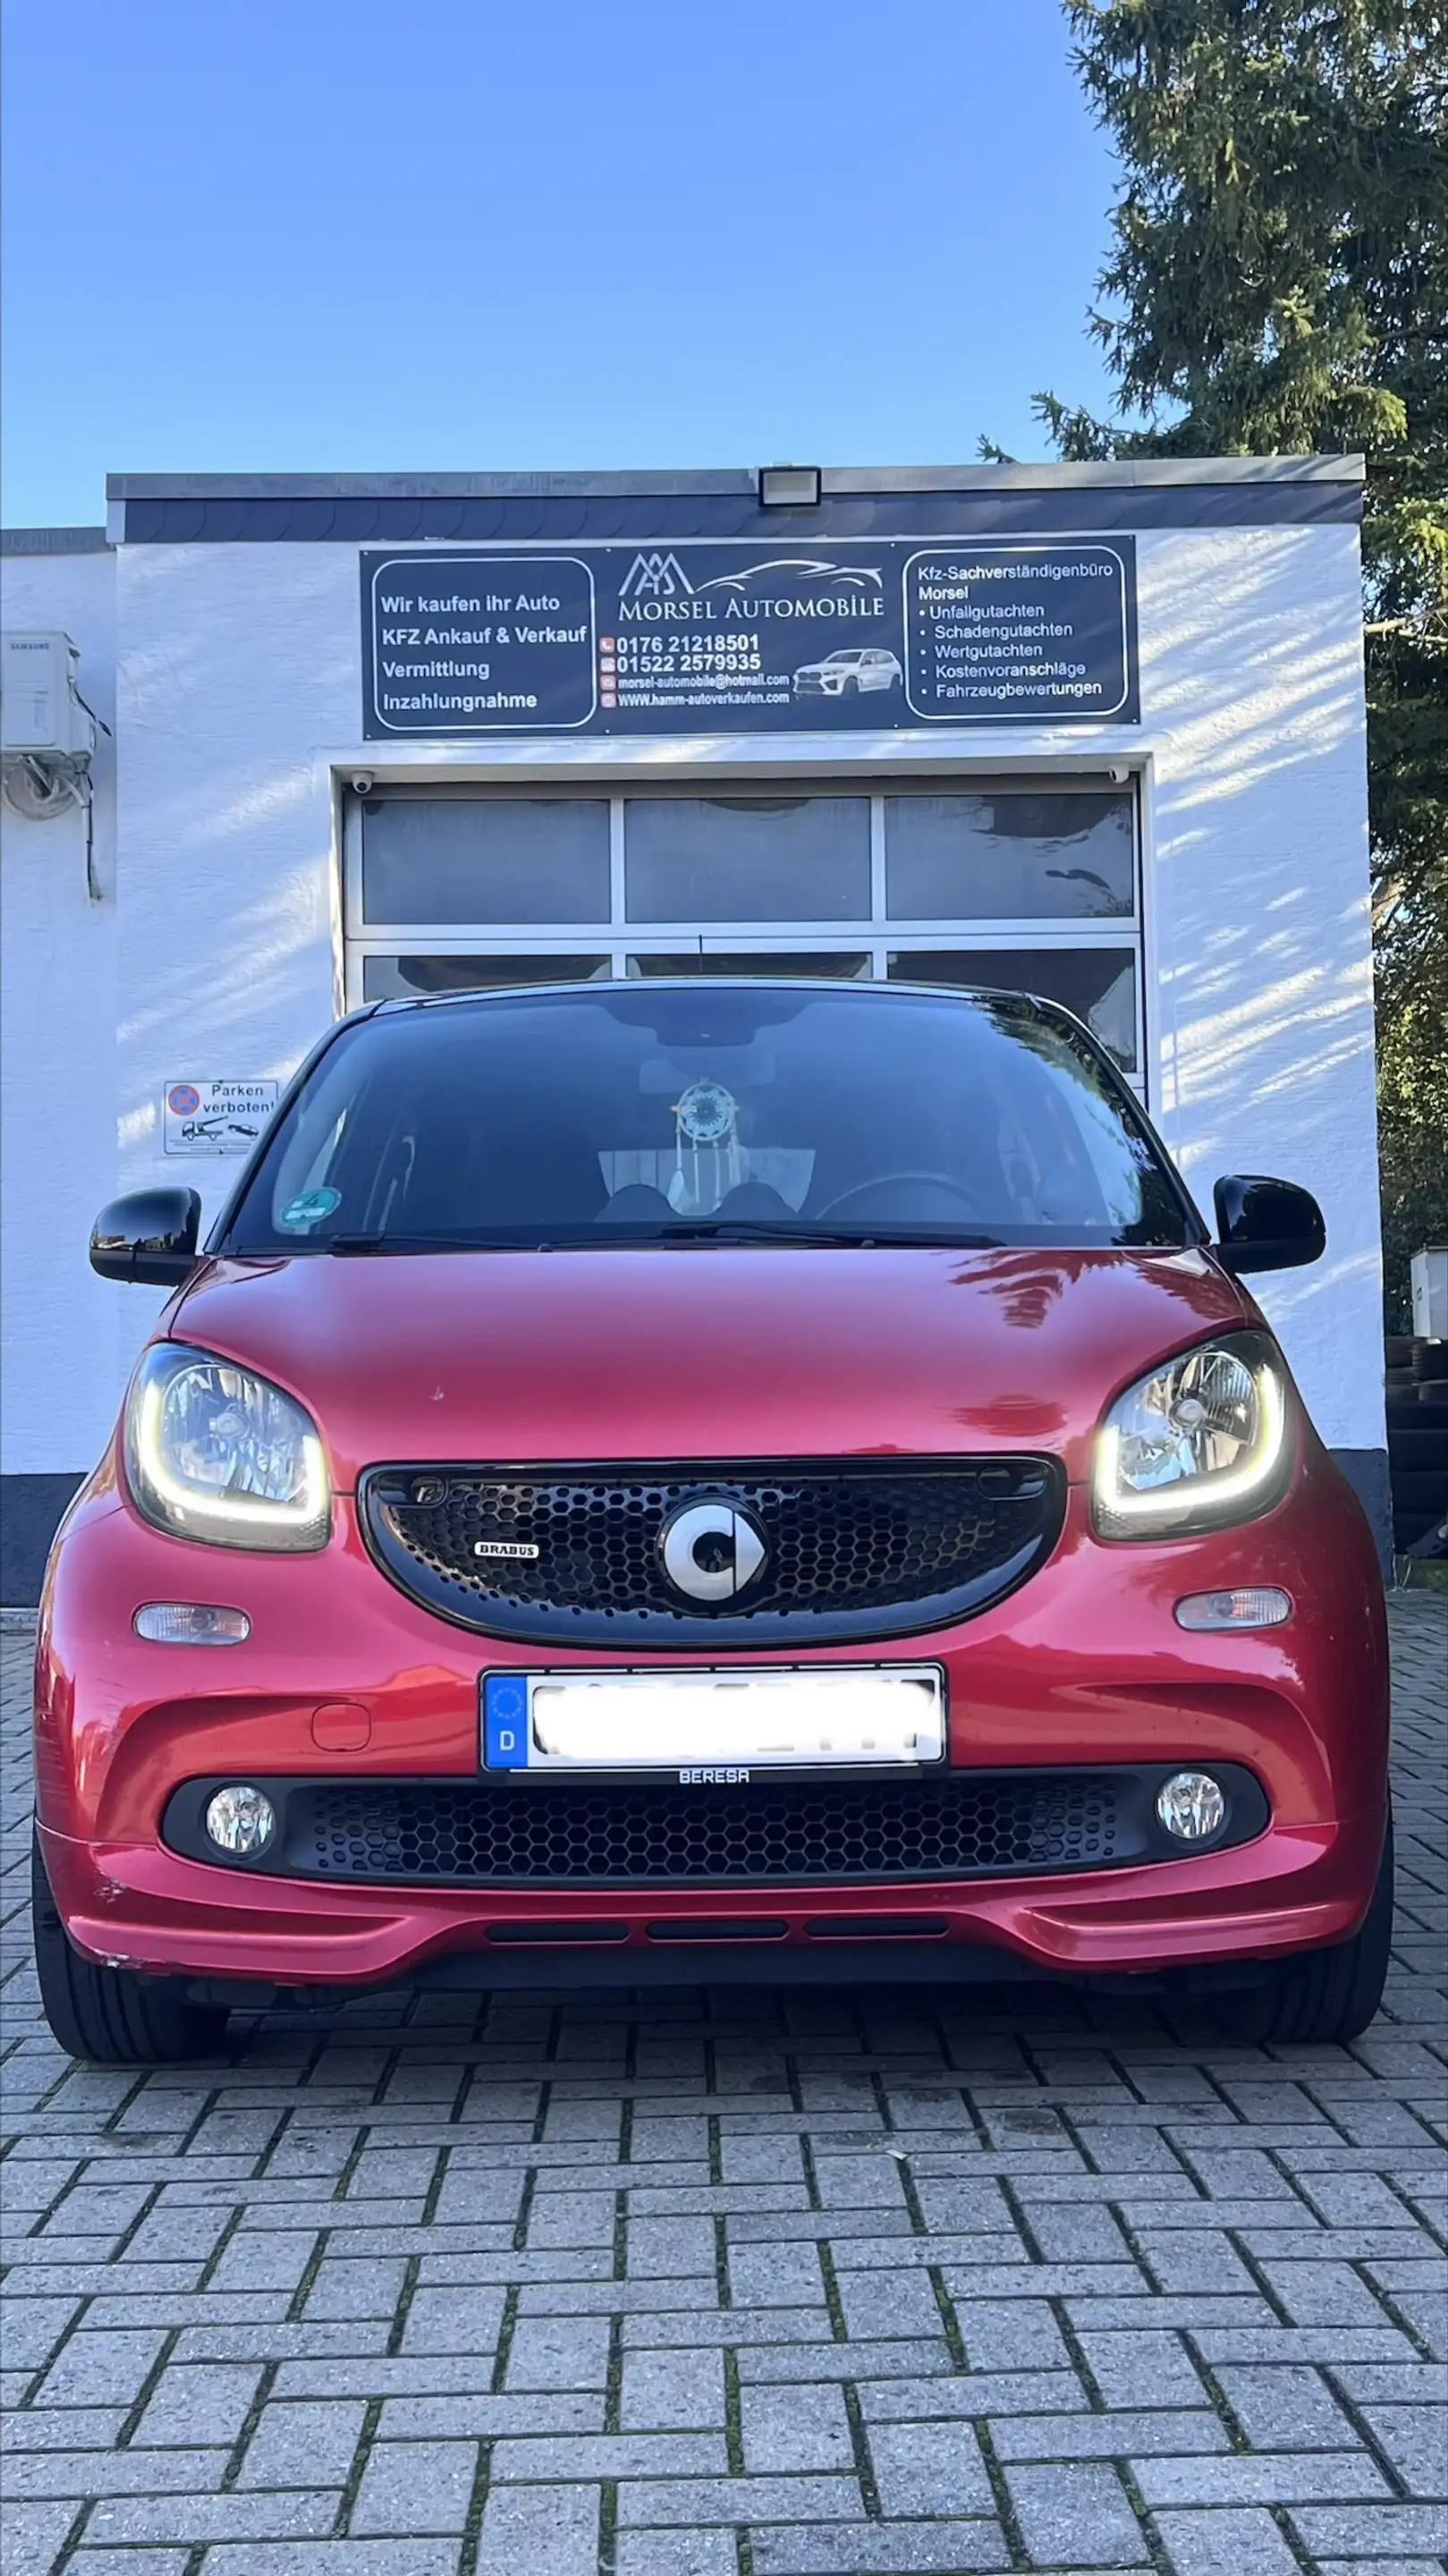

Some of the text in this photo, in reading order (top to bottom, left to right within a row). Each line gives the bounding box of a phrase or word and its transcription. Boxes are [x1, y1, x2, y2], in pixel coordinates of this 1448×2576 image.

[919, 564, 1113, 580] Kfz-Sachverständigenbüro
[919, 586, 969, 600] Morsel
[381, 597, 413, 613] Wir
[418, 596, 481, 612] kaufen
[515, 595, 561, 611] Auto
[618, 600, 717, 621] MORSEL
[930, 605, 1045, 622] Unfallgutachten
[382, 625, 588, 645] KFZ Ankauf & Verkauf
[935, 624, 1073, 640] Schadengutachten
[616, 634, 759, 653] 0176 21218501
[935, 644, 1042, 661] Wertgutachten
[383, 661, 490, 680] Vermittlung
[616, 654, 761, 673] 01522 2579935
[936, 663, 1086, 679] Kostenvoranschläge
[618, 674, 789, 690] morsel-automobile@hotmail.com
[936, 682, 1102, 699] Fahrzeugbewertungen
[384, 693, 538, 712] Inzahlungnahme
[212, 1084, 264, 1097] Parken
[479, 1545, 534, 1555] BRABUS
[499, 1730, 515, 1750] D
[679, 1769, 749, 1784] BERESA
